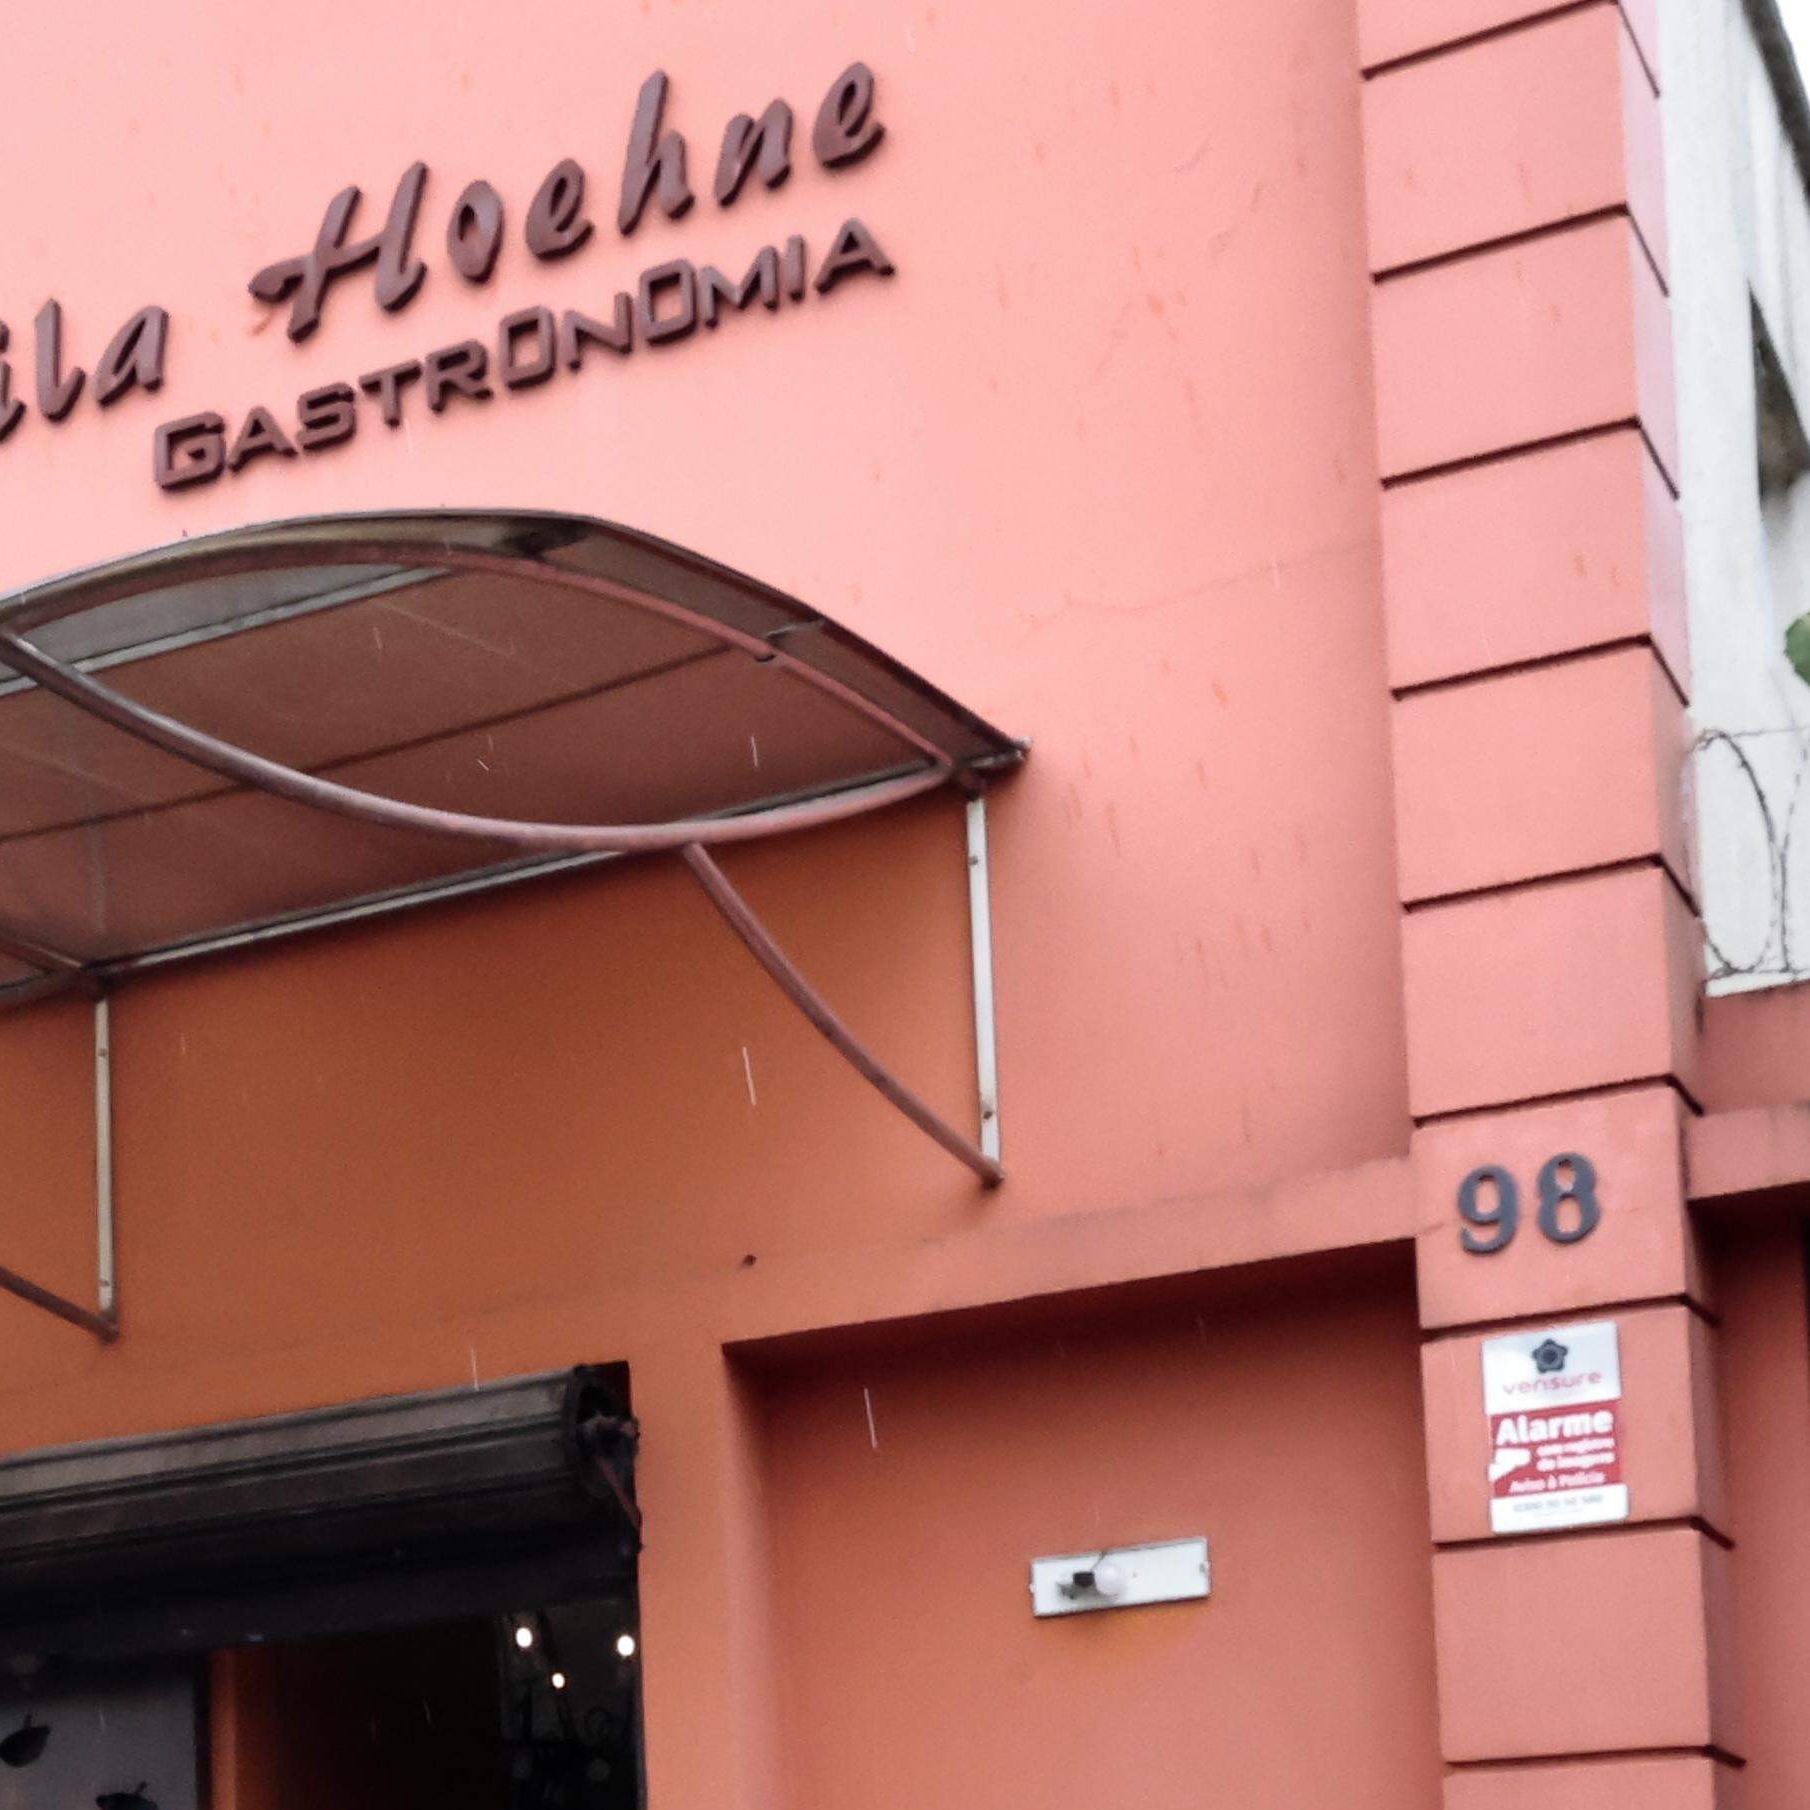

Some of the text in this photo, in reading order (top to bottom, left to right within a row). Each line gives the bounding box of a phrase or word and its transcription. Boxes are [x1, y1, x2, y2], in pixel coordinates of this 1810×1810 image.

[248, 61, 887, 343] Hoehne
[153, 217, 897, 494] GASTRONOMIA
[1457, 1152, 1601, 1257] 98
[1496, 1410, 1614, 1446] Alarme
